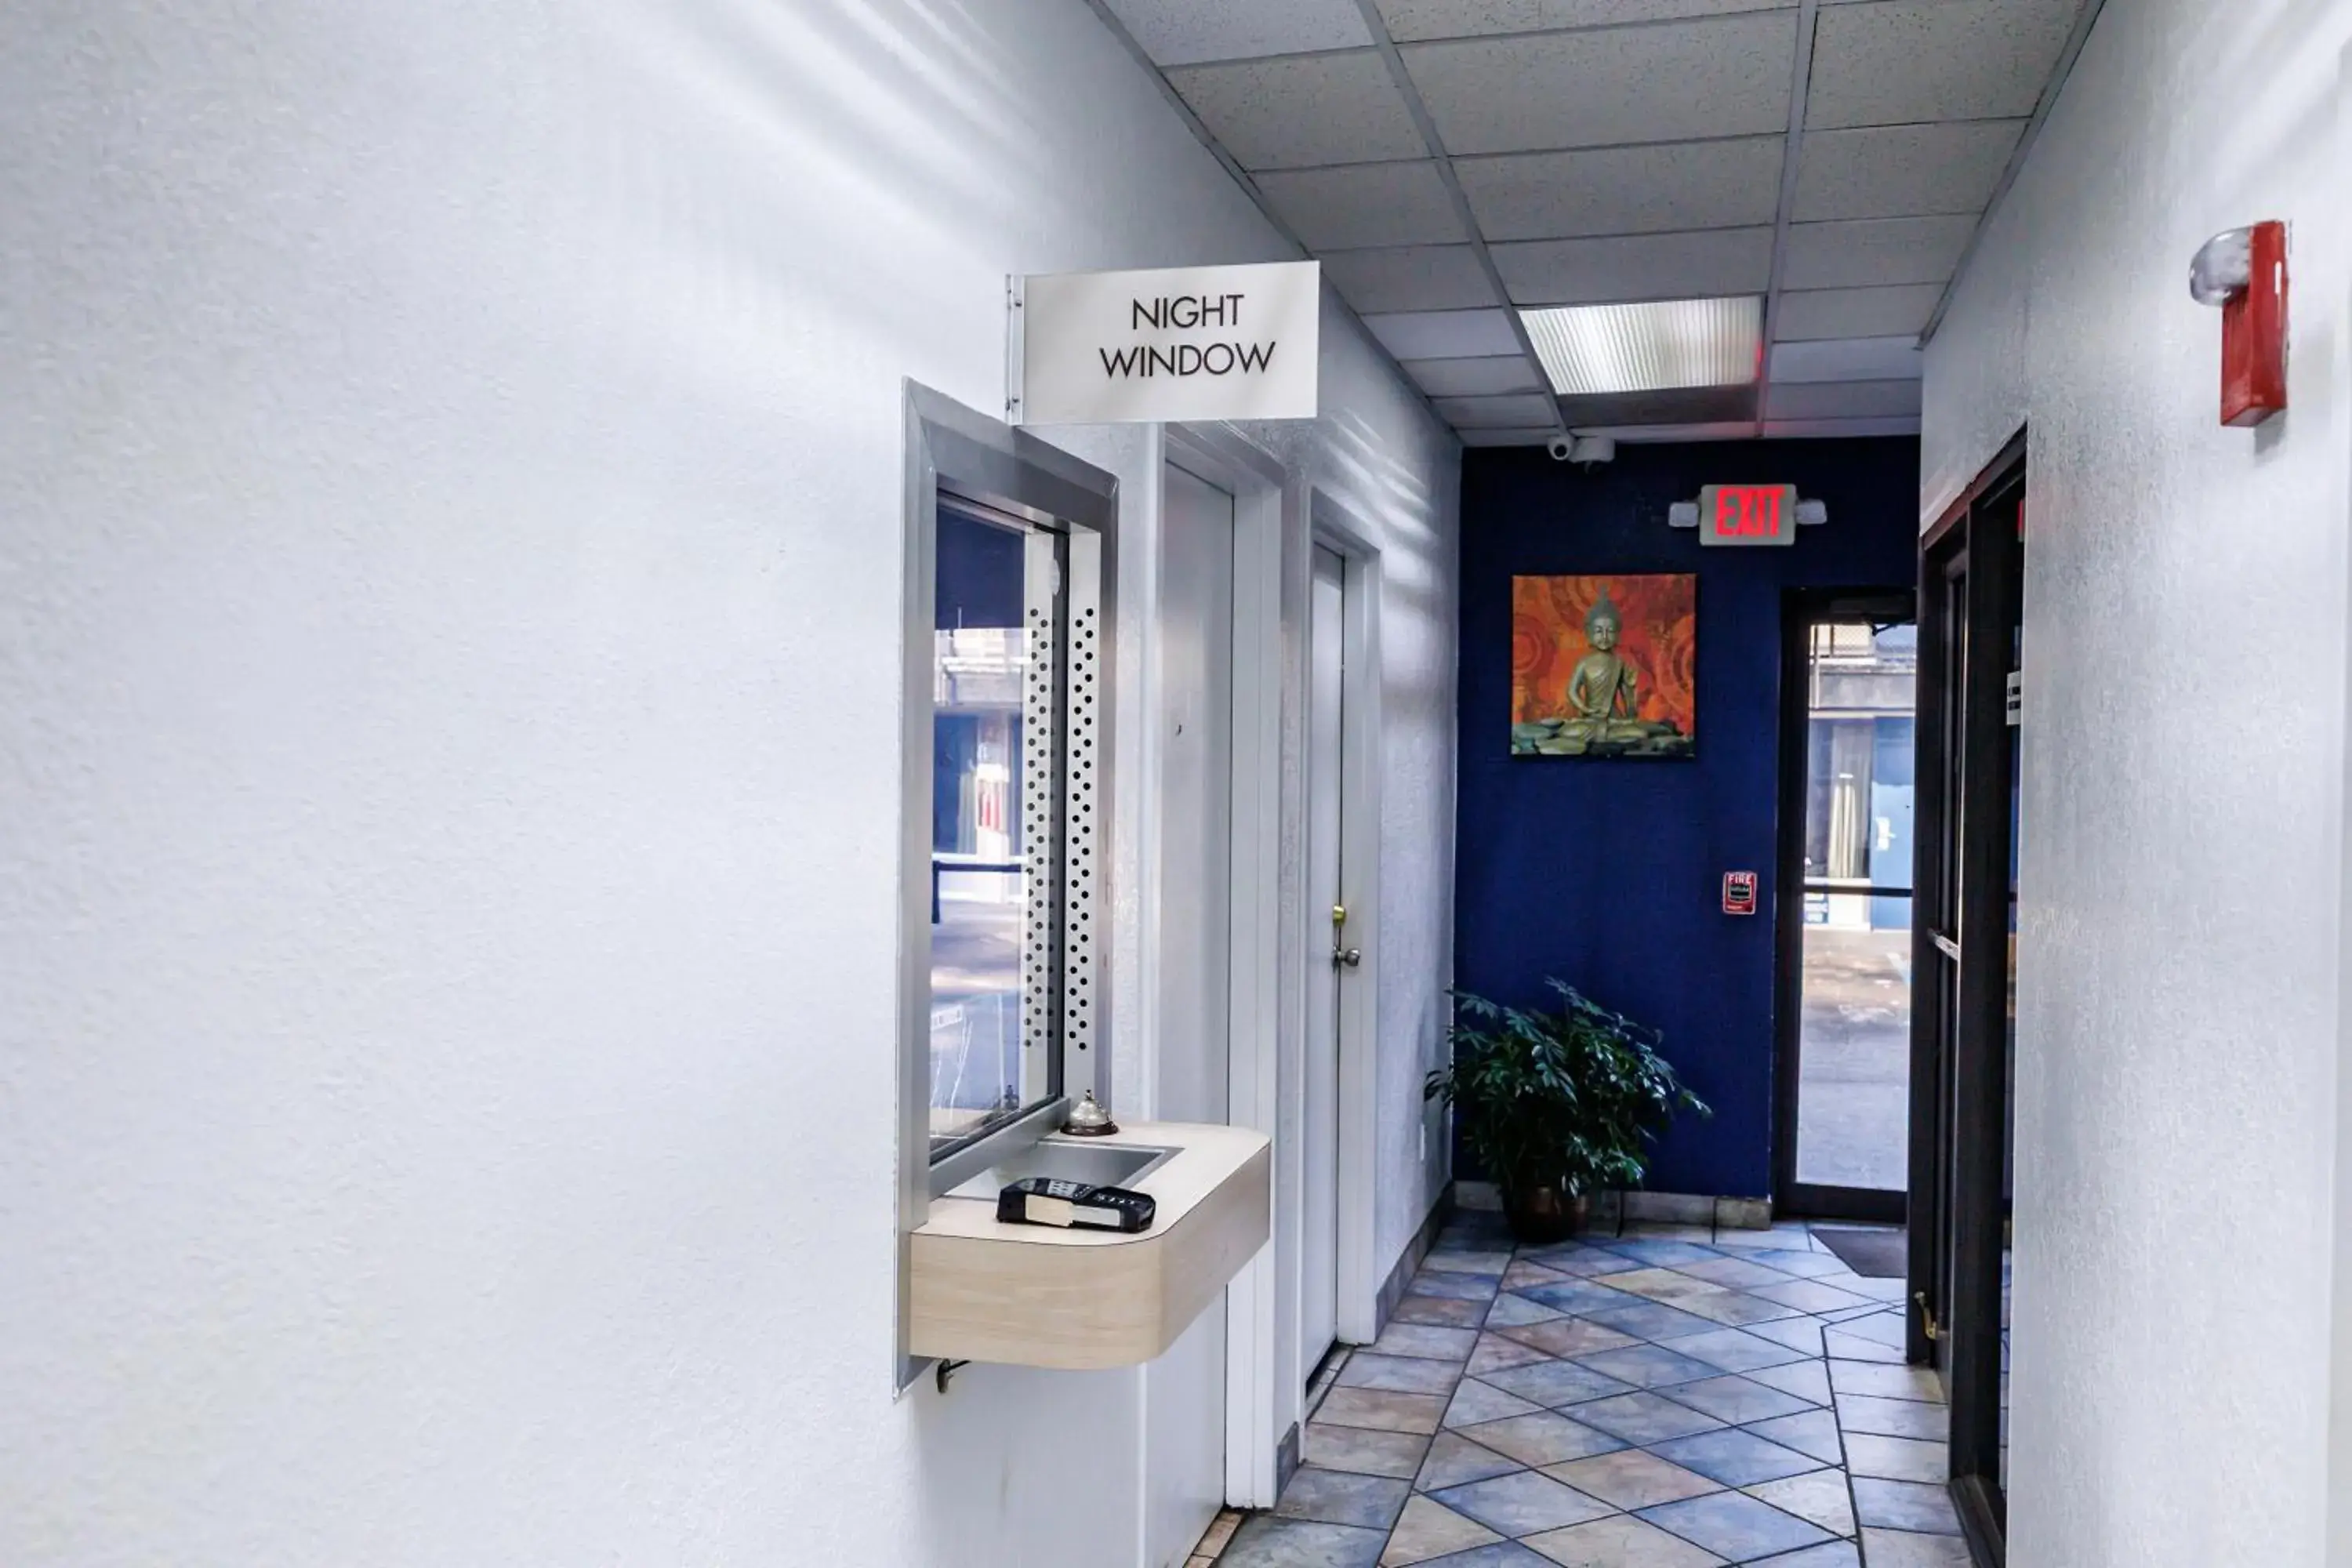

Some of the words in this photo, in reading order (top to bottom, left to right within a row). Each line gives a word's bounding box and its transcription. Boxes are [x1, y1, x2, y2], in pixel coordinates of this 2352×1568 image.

[1133, 294, 1245, 330] NIGHT
[1099, 341, 1276, 378] WINDOW
[1716, 486, 1785, 536] EXIT
[1728, 873, 1752, 884] FIRE
